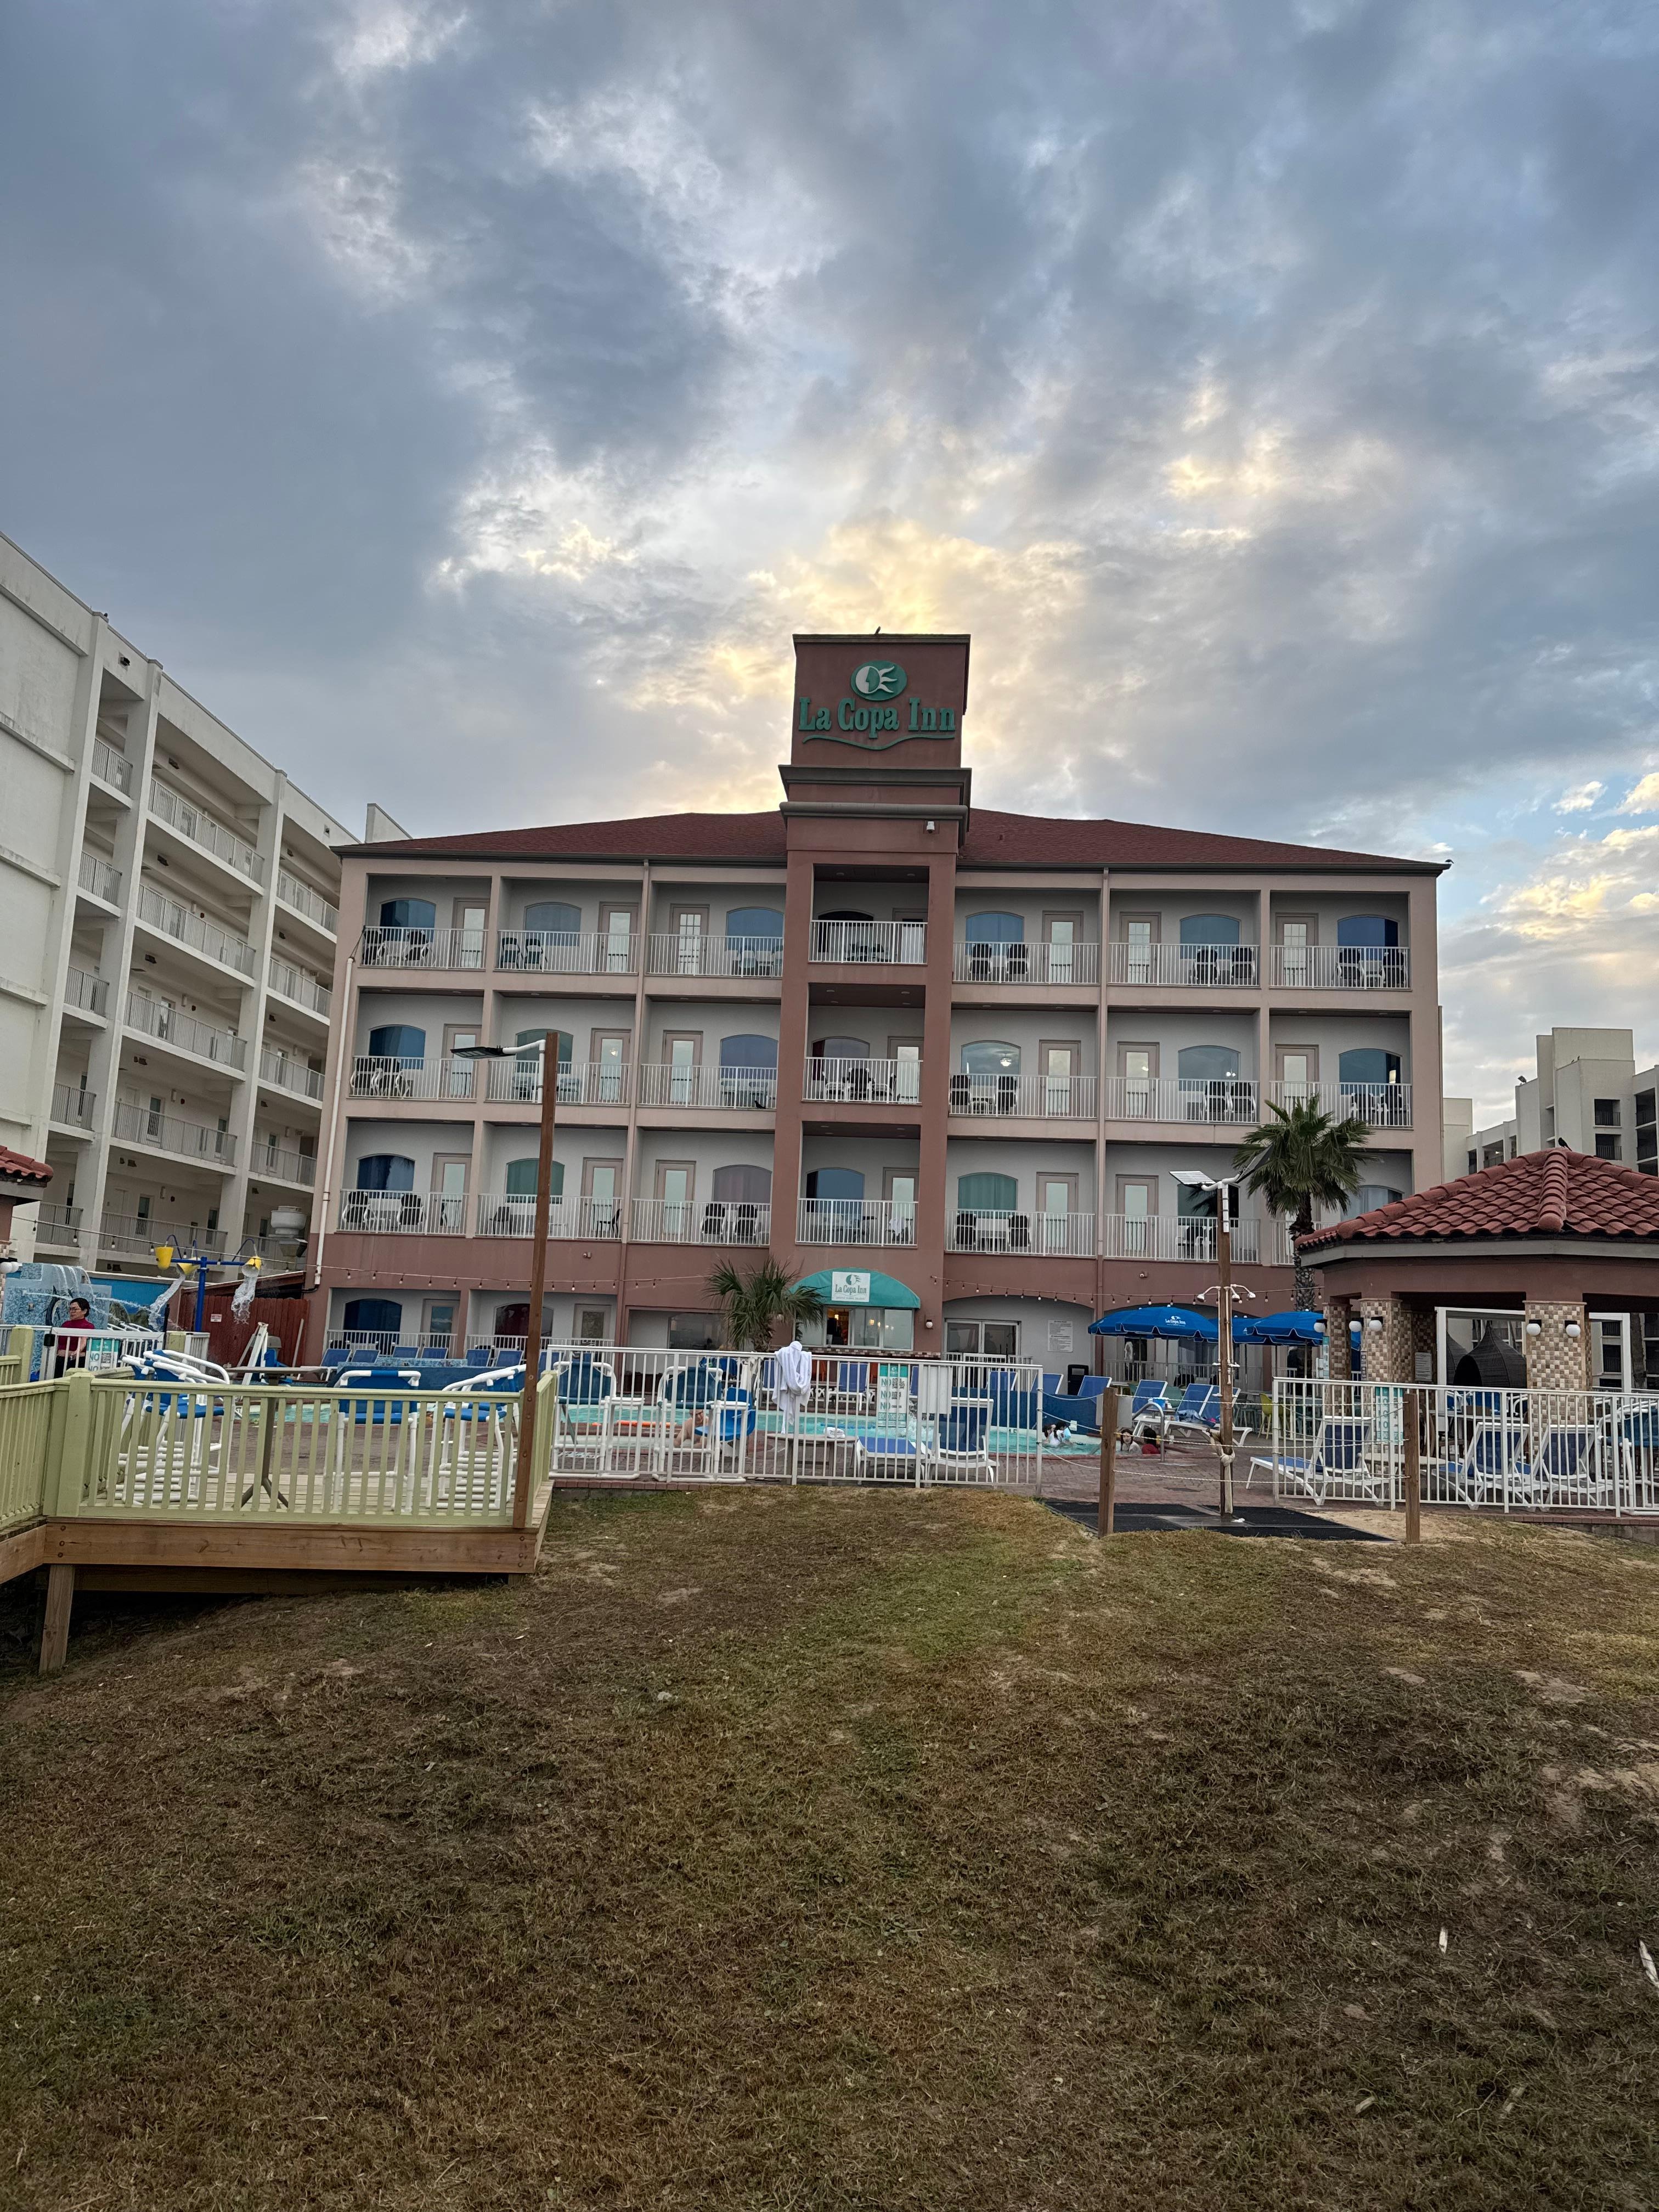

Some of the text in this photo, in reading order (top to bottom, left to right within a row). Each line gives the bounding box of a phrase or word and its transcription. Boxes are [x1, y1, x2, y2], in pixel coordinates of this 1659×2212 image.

[798, 697, 956, 739] La Copa Inn
[835, 1284, 867, 1295] La Copa Inn
[89, 1353, 100, 1361] NO
[881, 1378, 891, 1387] NO
[881, 1390, 891, 1398] NO
[880, 1402, 891, 1410] NO
